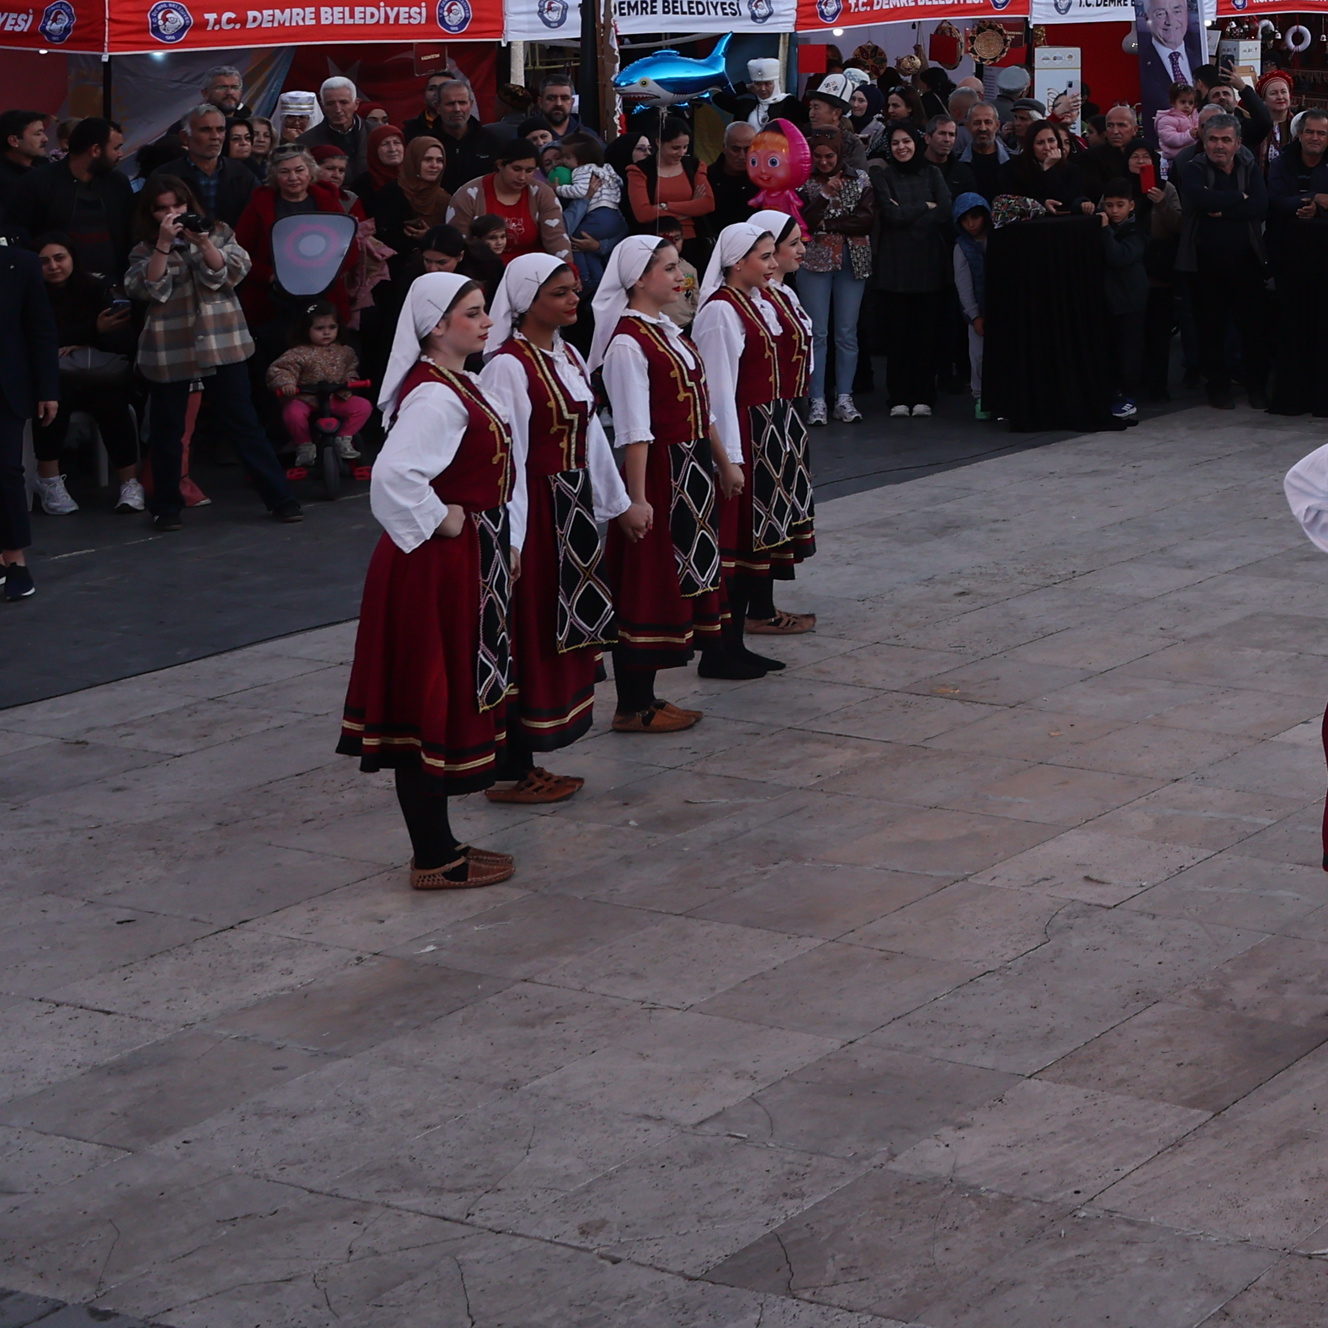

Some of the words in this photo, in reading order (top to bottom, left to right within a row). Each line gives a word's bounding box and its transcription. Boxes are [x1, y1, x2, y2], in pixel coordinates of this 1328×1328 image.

[203, 12, 241, 31] T.C.
[246, 7, 316, 29] DEMRE
[319, 1, 427, 26] BELEDİYESİ
